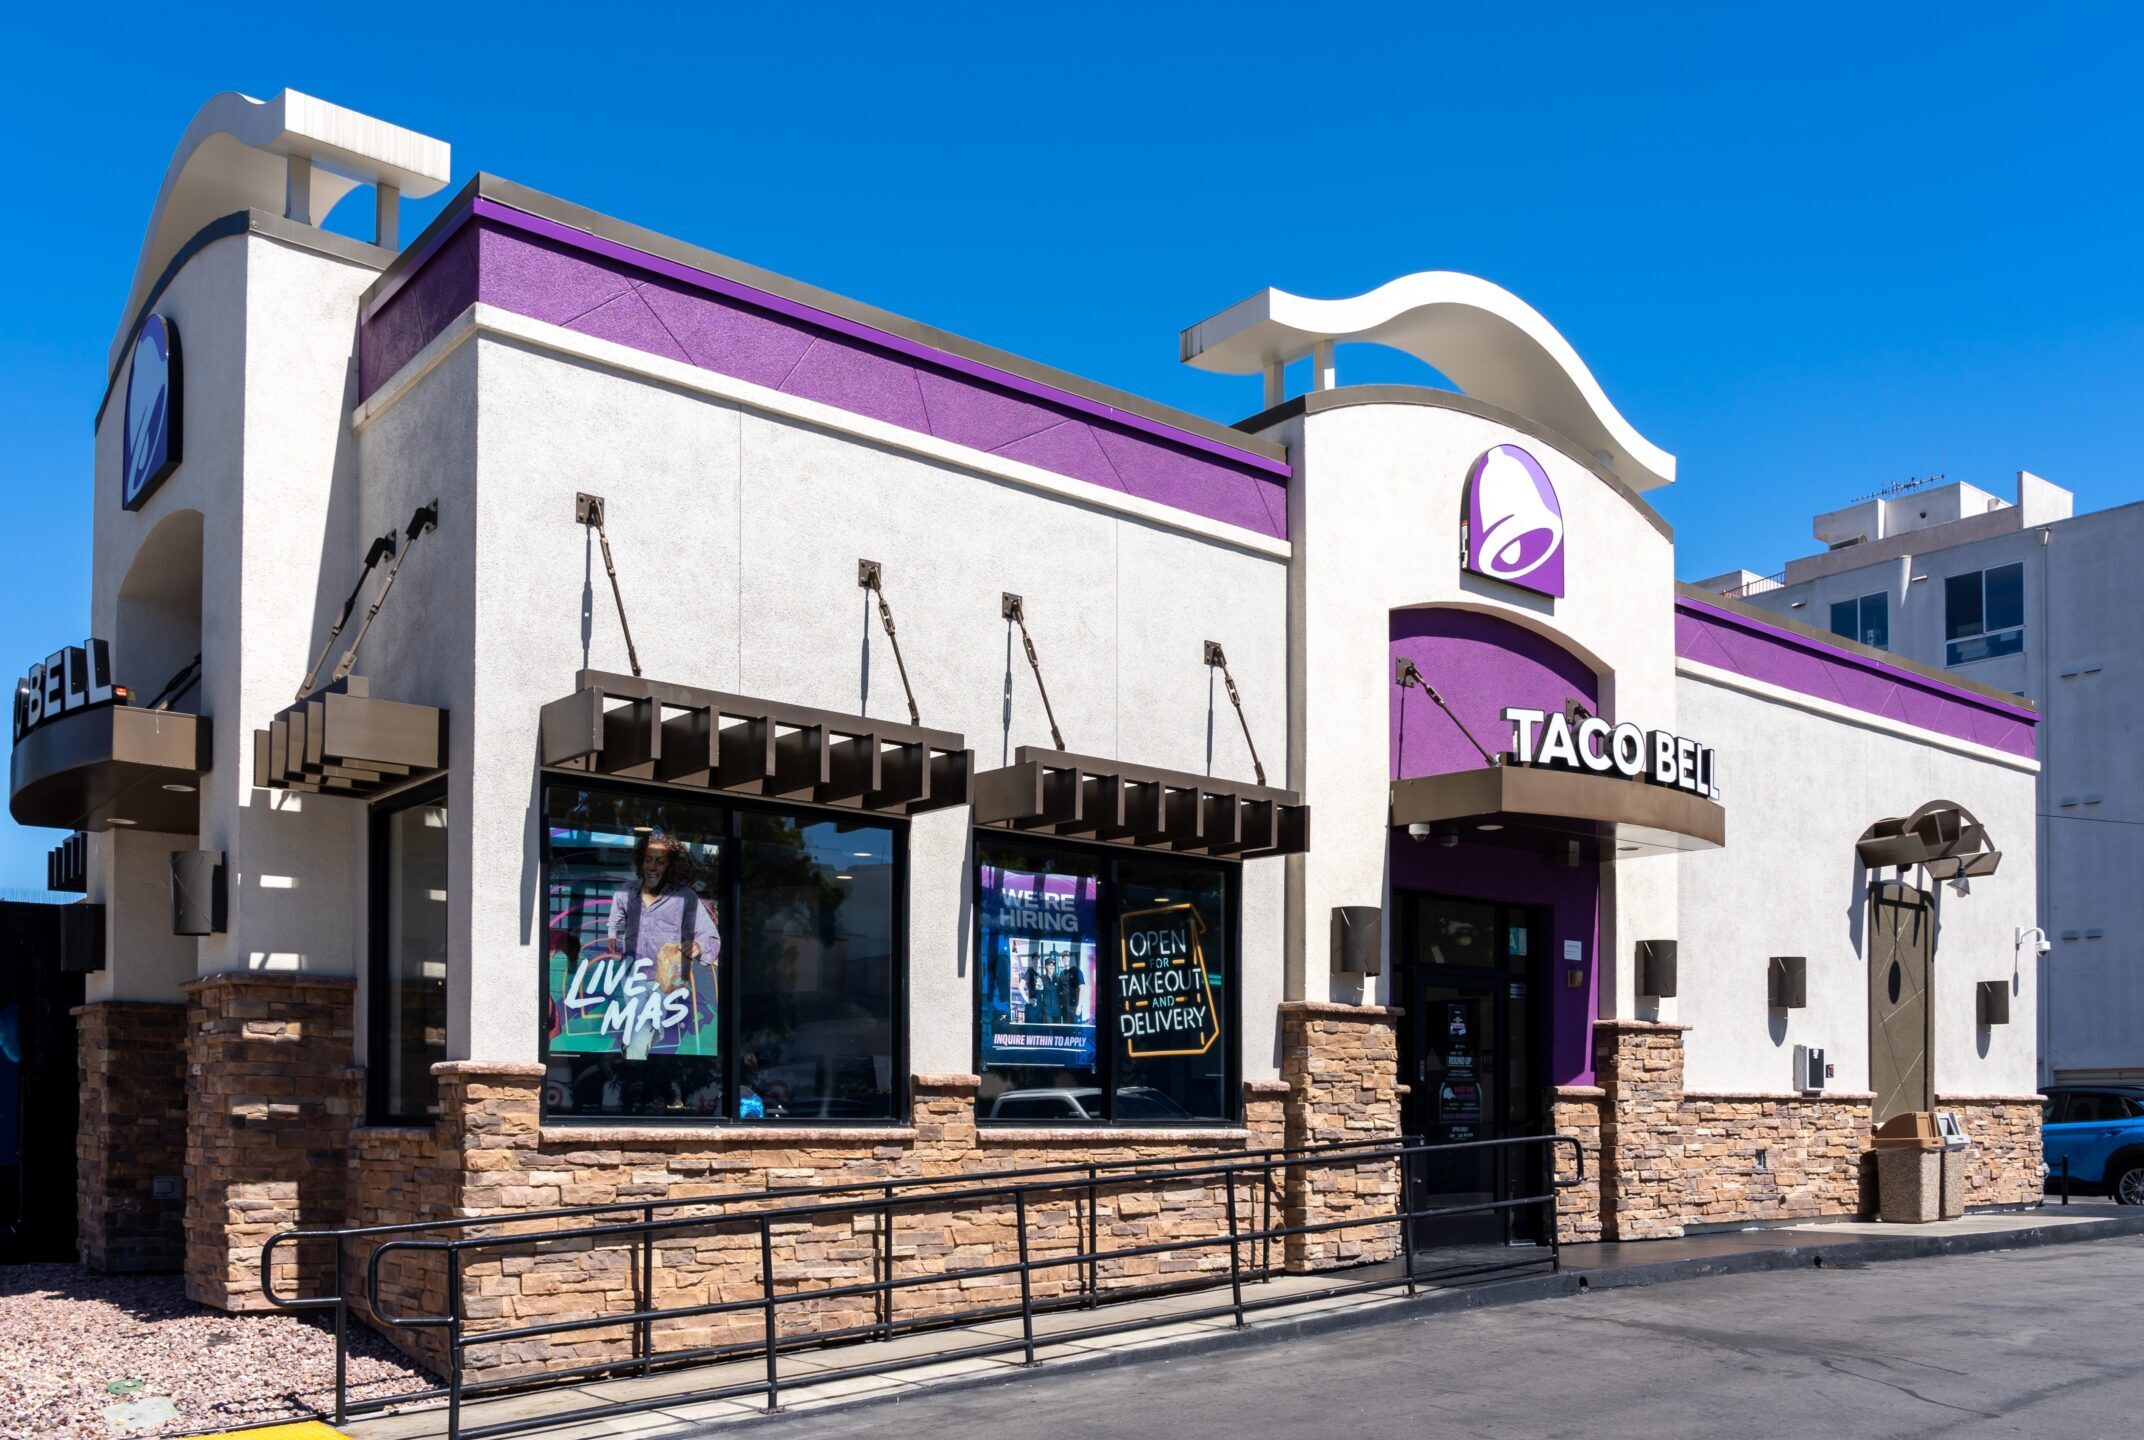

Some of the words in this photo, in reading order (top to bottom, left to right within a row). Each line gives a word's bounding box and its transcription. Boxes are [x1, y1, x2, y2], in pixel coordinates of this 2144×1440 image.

[28, 638, 112, 727] BELL
[1506, 707, 1646, 776] TACO
[1655, 730, 1720, 800] BELL
[1002, 888, 1075, 911] WE'RE
[1000, 908, 1079, 932] HIRING
[1130, 929, 1186, 956] OPEN
[1150, 957, 1169, 968] FOR
[564, 958, 653, 1009] LIVE
[1119, 968, 1201, 996] TAKEOUT
[1152, 995, 1174, 1008] AND
[1120, 1005, 1206, 1037] DELIVERY
[993, 1033, 1026, 1046] INQUIRE
[1026, 1034, 1053, 1046] WITHIN
[1054, 1036, 1064, 1046] TO
[1064, 1036, 1087, 1046] APPLY
